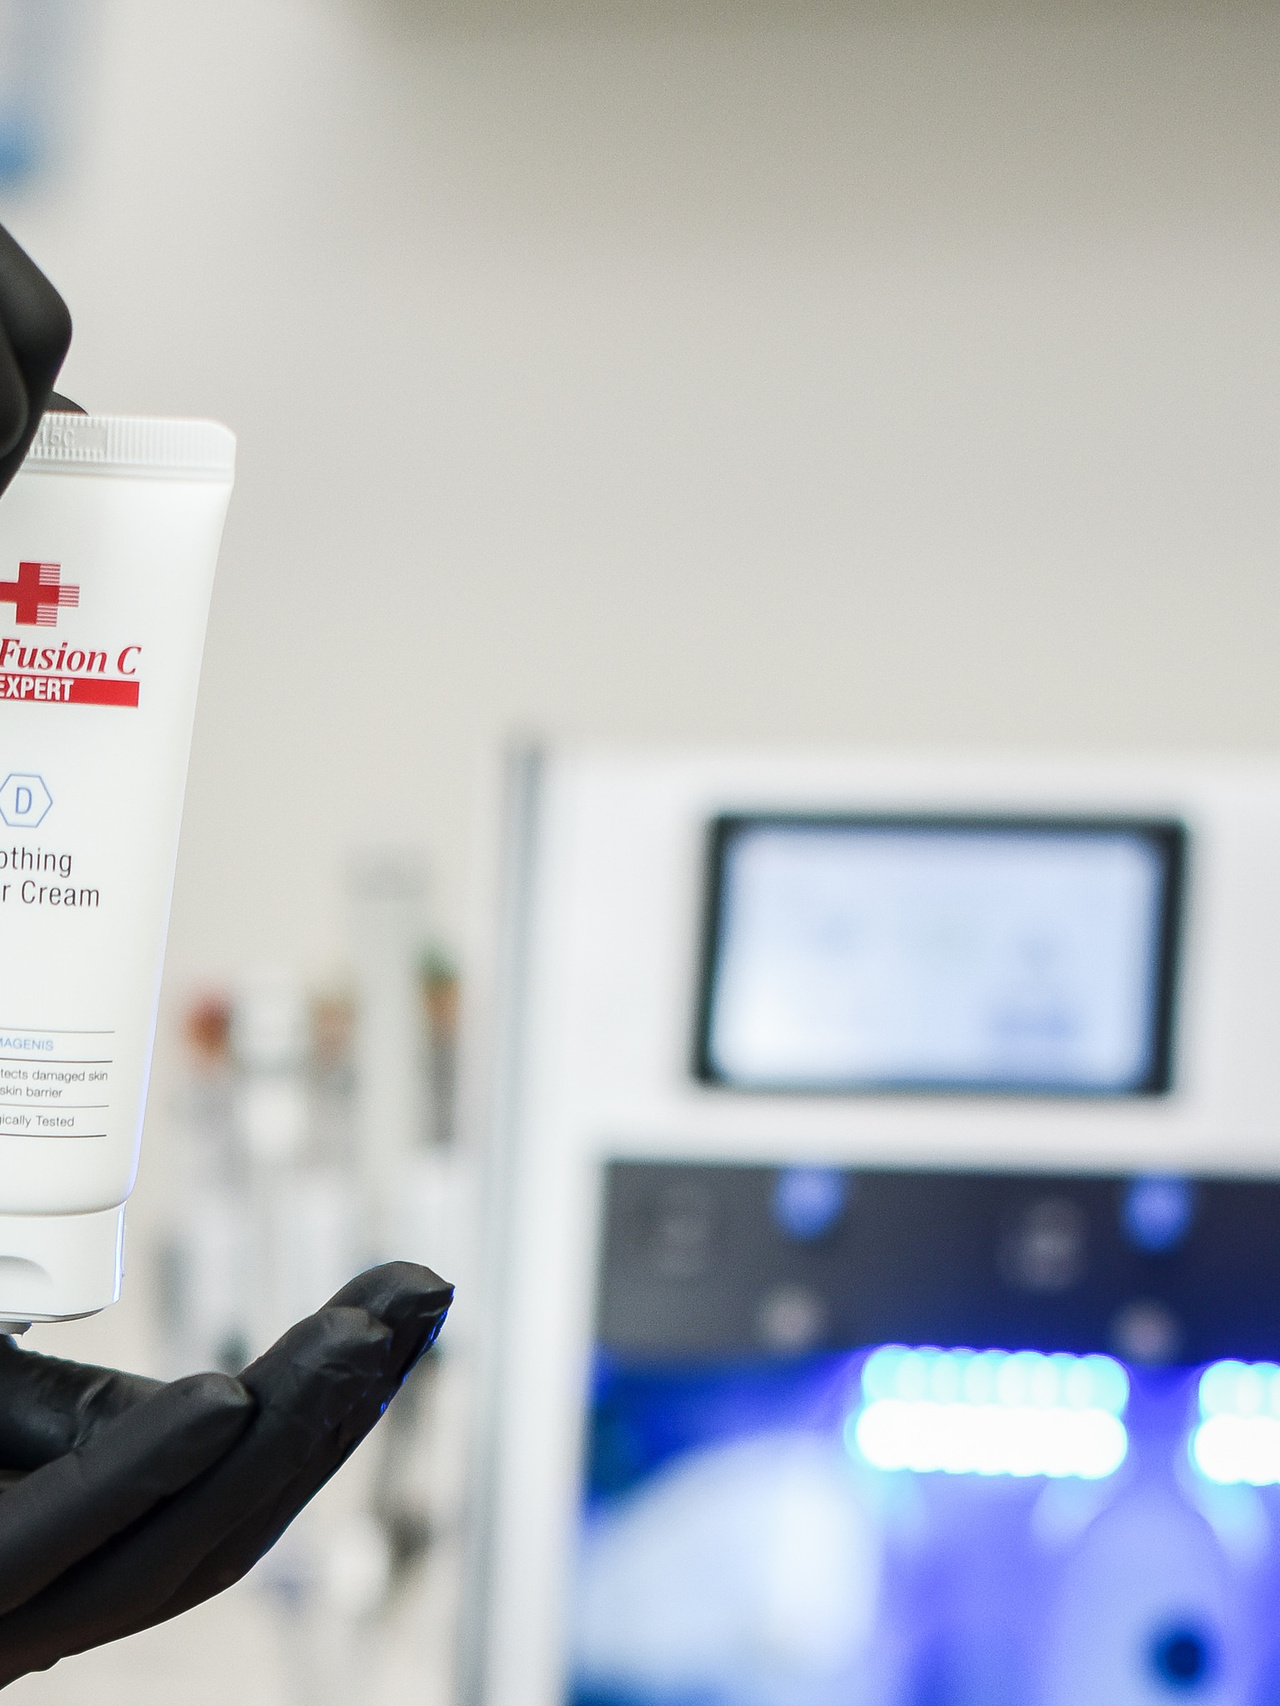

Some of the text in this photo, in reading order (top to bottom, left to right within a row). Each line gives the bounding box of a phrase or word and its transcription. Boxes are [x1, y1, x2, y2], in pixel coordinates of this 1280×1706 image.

[117, 645, 142, 675] C
[15, 786, 33, 814] D
[21, 880, 100, 907] Cream
[32, 1070, 85, 1083] damaged
[88, 1070, 108, 1081] skin
[0, 1085, 22, 1096] skin
[26, 1086, 63, 1098] barrier
[35, 1115, 75, 1127] Tested
